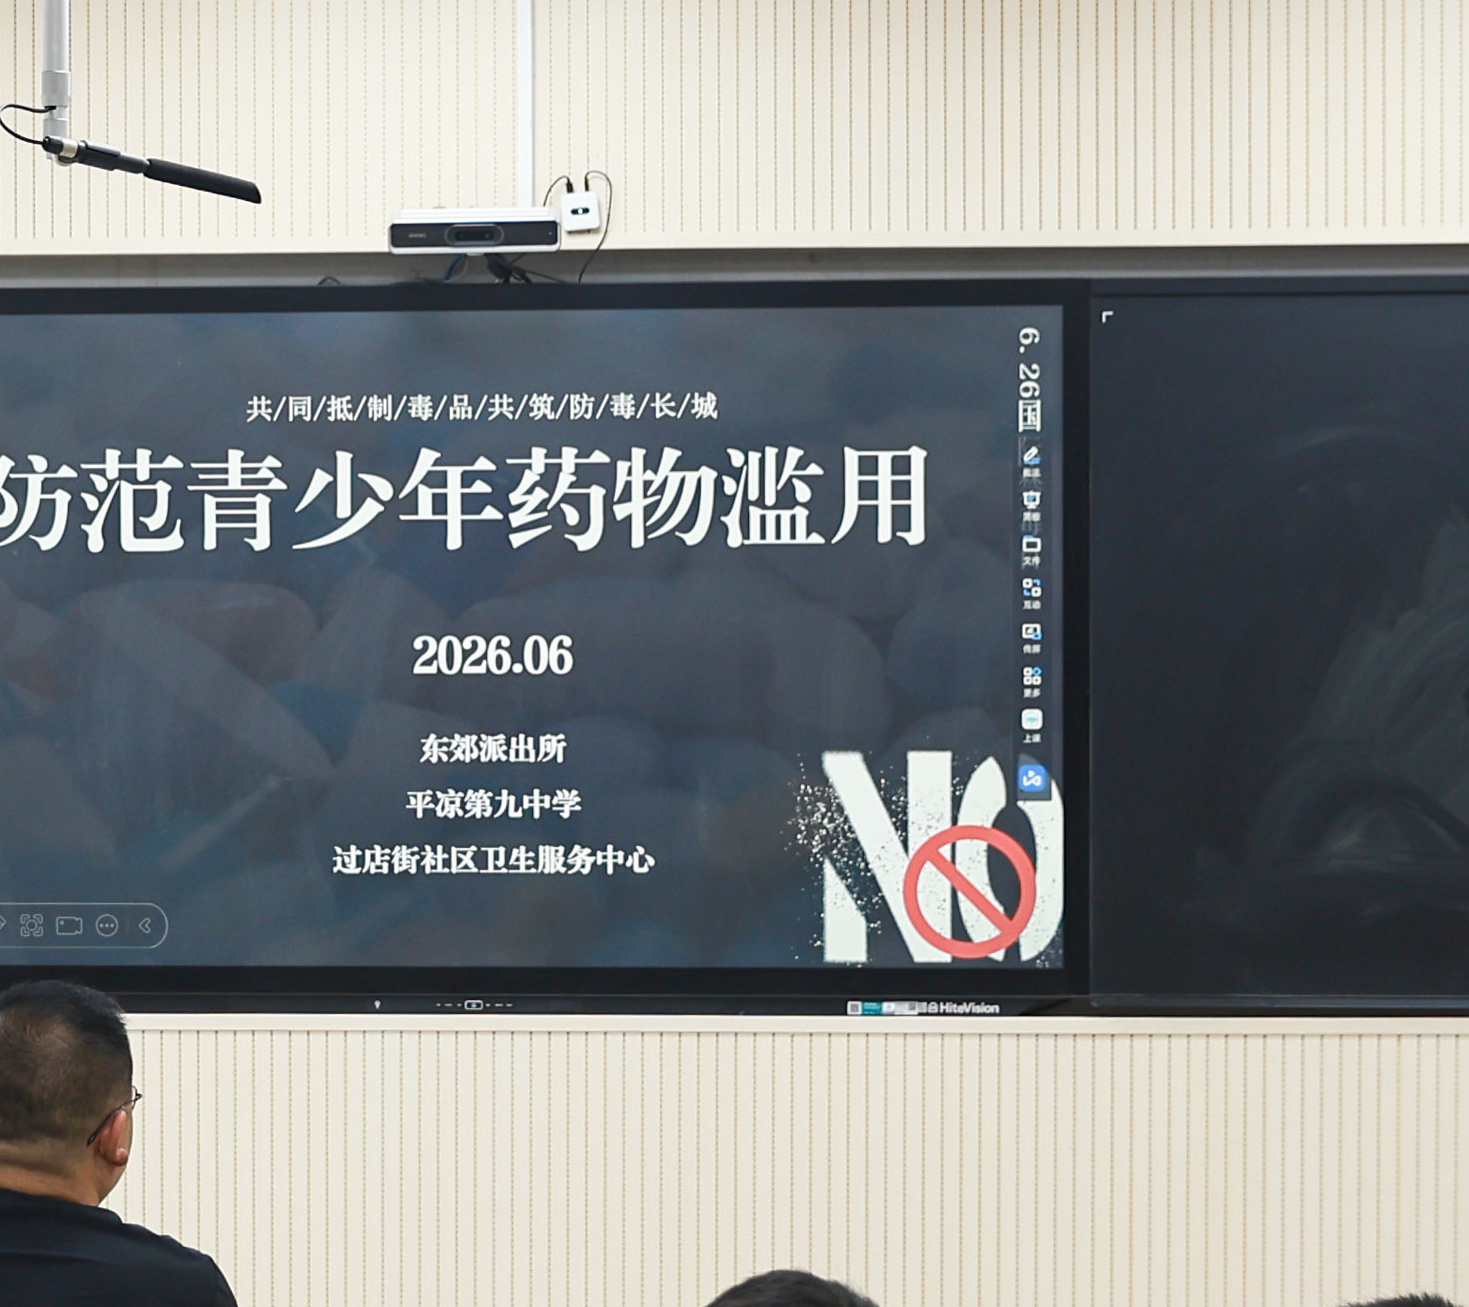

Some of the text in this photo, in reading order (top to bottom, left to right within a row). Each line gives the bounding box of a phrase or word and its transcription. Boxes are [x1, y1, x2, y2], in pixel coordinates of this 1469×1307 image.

[412, 633, 574, 676] 2026.06
[418, 732, 569, 764] 东郊派出所
[404, 787, 583, 820] 平凉第九中学
[332, 843, 656, 876] 过店街社区卫生服务中心
[939, 1000, 1000, 1014] HiteVision
